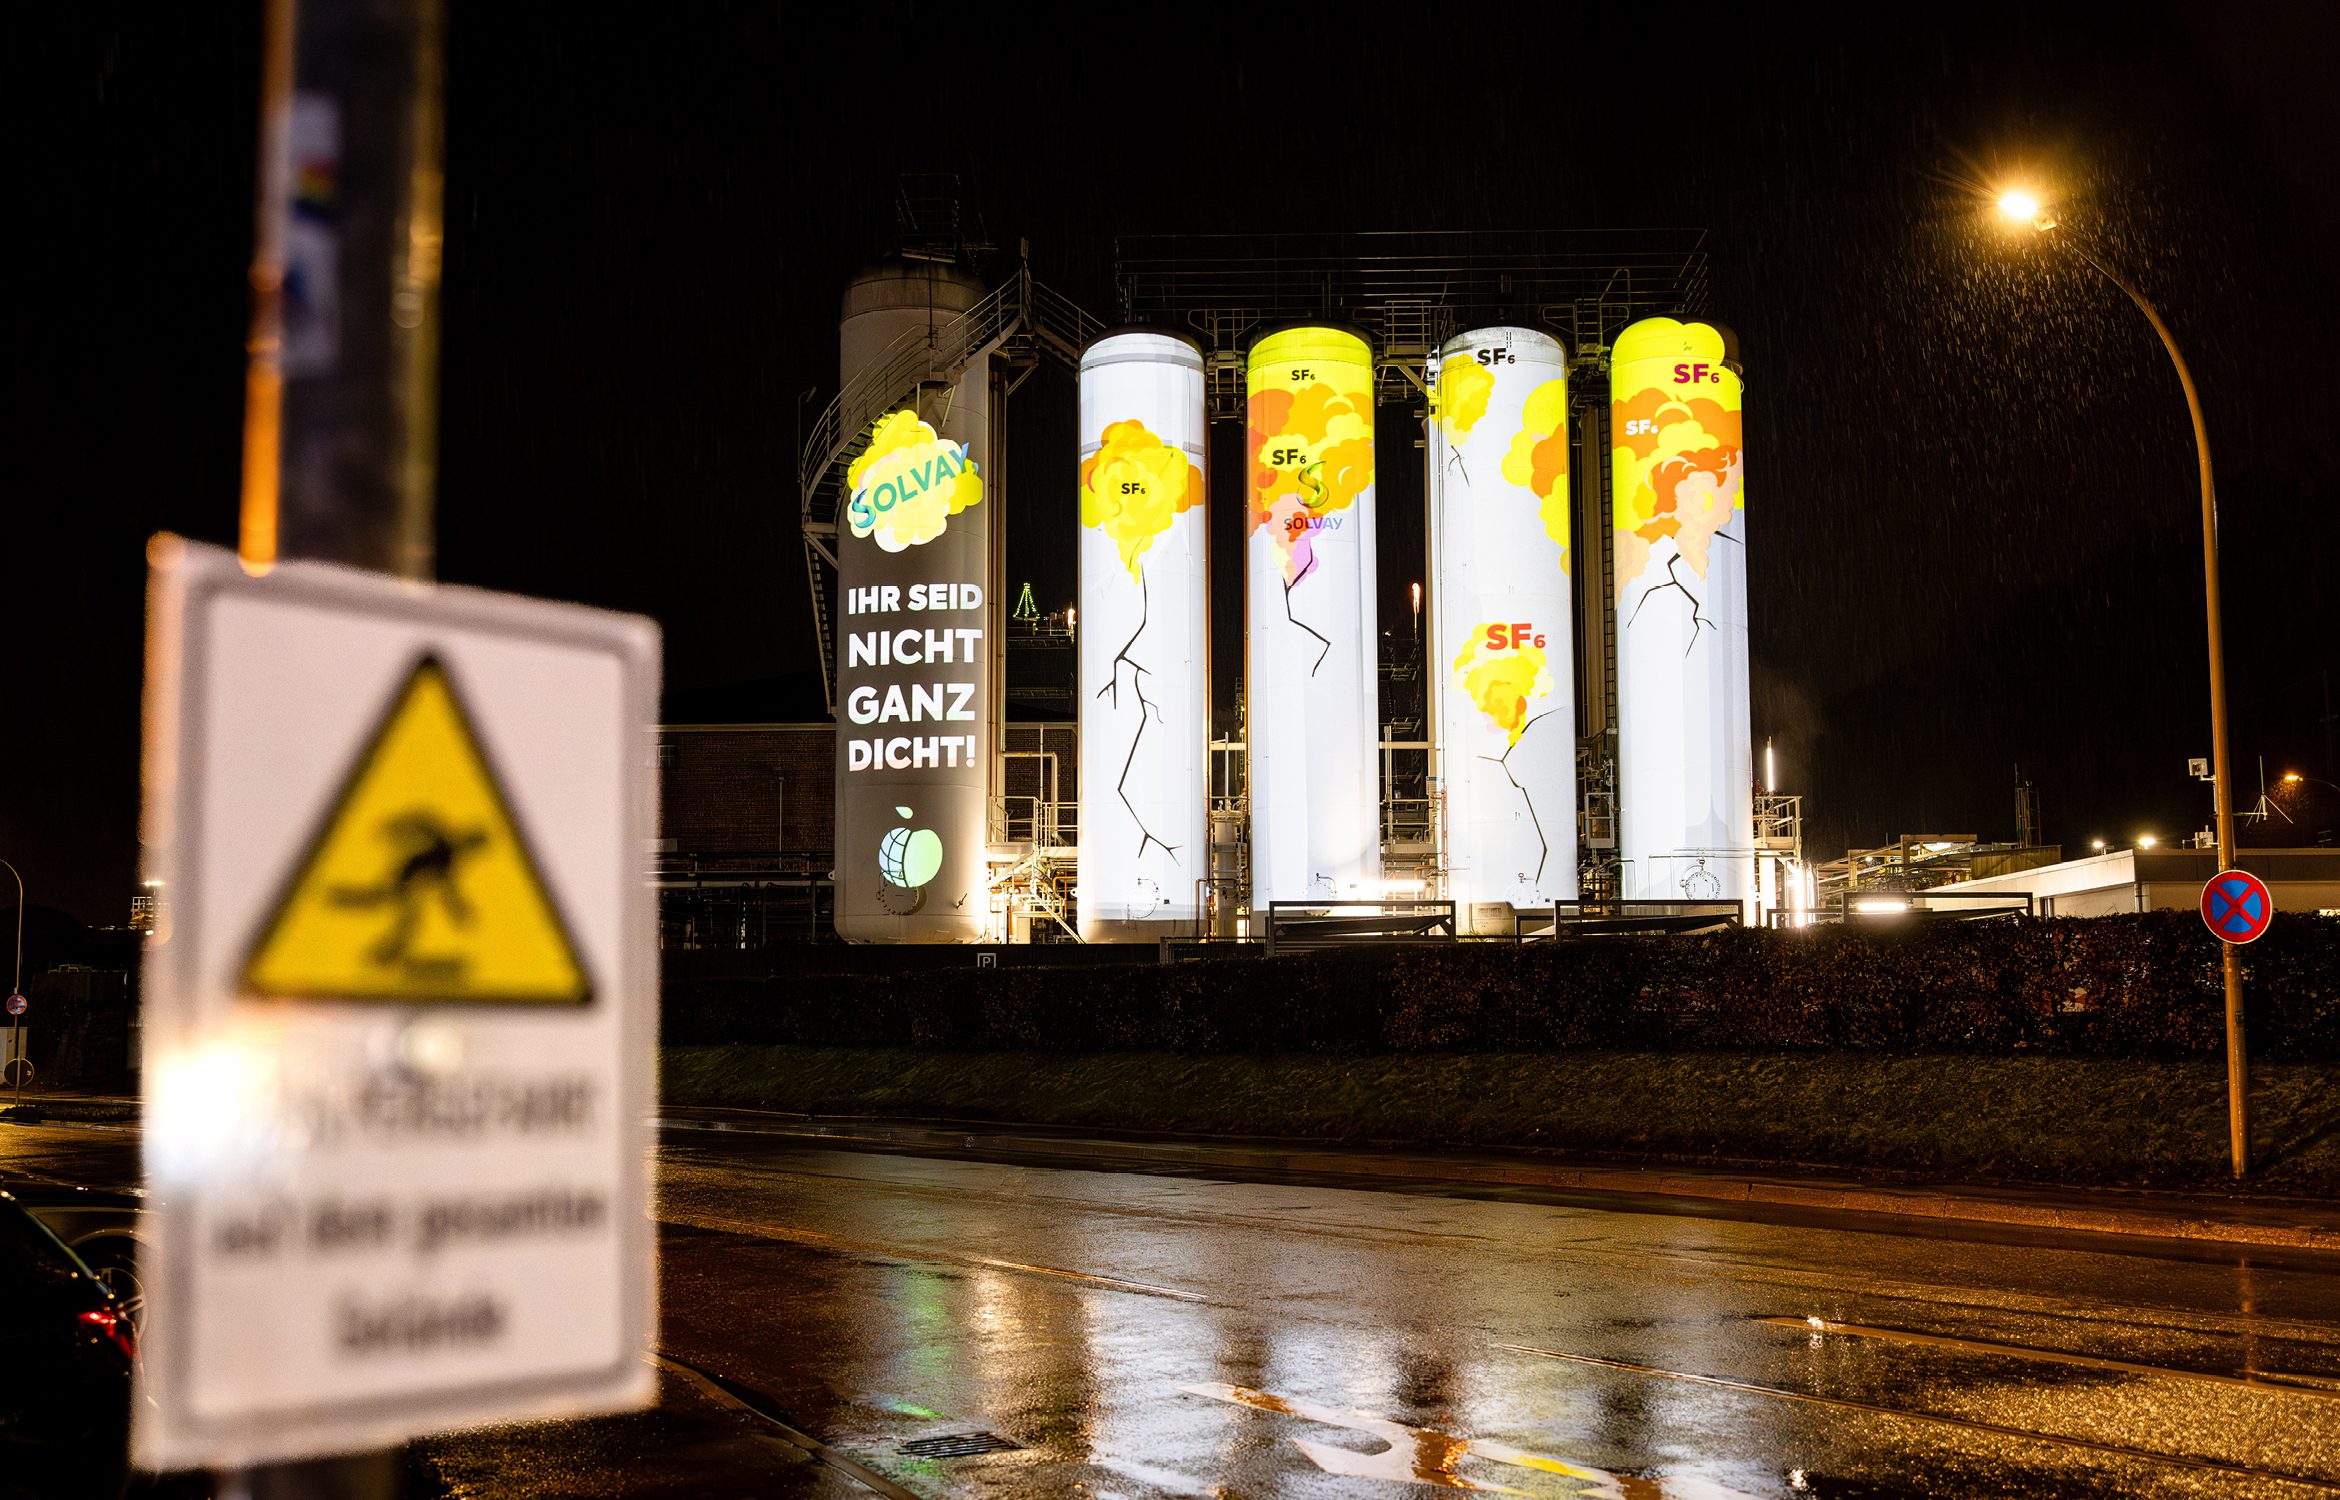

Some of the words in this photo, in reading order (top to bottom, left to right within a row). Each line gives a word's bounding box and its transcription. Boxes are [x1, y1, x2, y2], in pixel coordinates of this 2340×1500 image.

[851, 442, 970, 529] SOLVAY
[1284, 517, 1343, 531] SOLVAY
[848, 585, 901, 615] IHR
[907, 583, 983, 612] SEID
[848, 628, 984, 668] NICHT
[847, 683, 976, 725] GANZ
[848, 735, 977, 772] DICHT!
[982, 956, 992, 968] P
